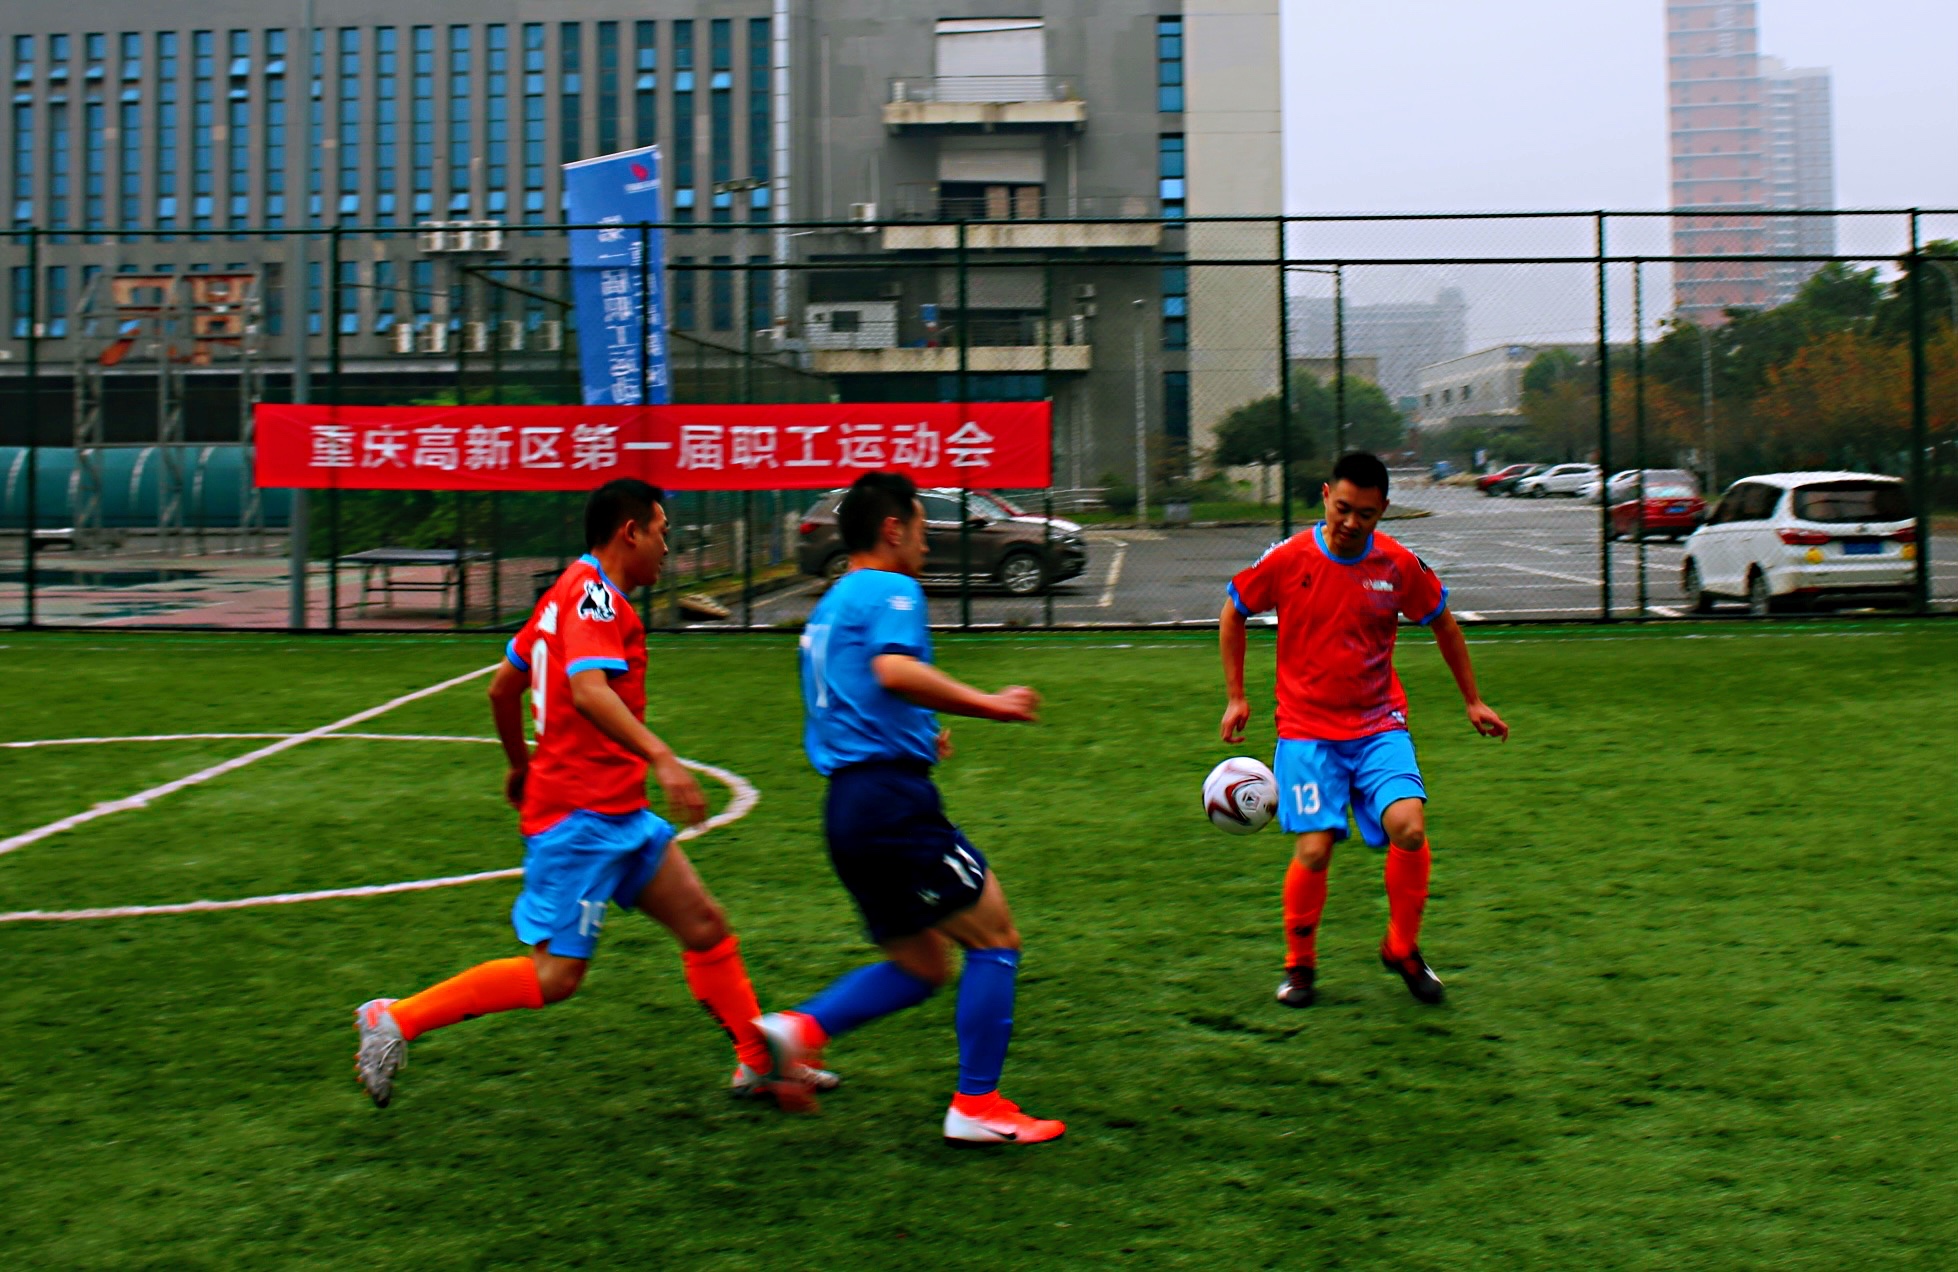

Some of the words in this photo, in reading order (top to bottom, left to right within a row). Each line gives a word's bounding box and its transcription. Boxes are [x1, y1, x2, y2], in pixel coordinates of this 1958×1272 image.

[309, 421, 995, 472] 重庆高新区第一届职工运动会
[1291, 783, 1320, 815] 13
